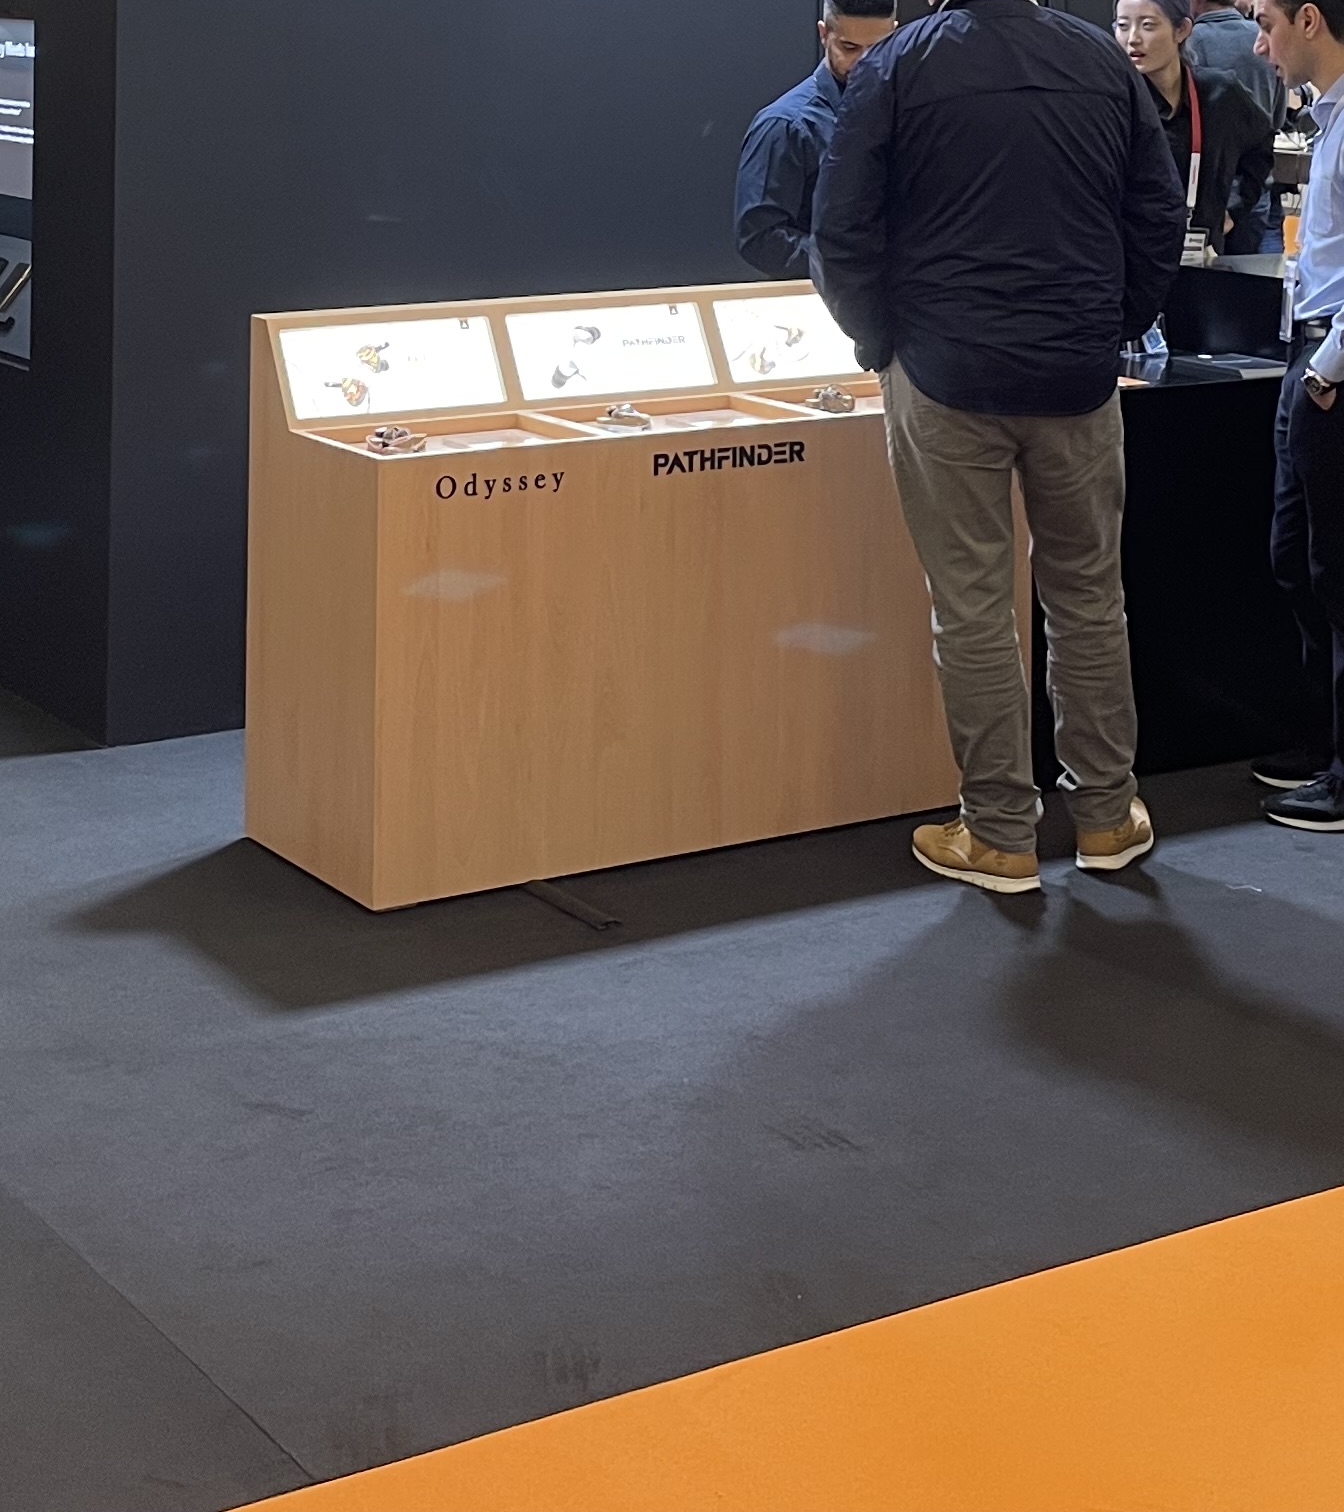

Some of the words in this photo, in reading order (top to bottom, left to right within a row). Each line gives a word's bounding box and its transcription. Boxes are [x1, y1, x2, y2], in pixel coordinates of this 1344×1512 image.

[622, 336, 686, 347] PATHFINDER
[653, 441, 805, 477] PATHFINDER
[436, 471, 565, 500] Odyssey
